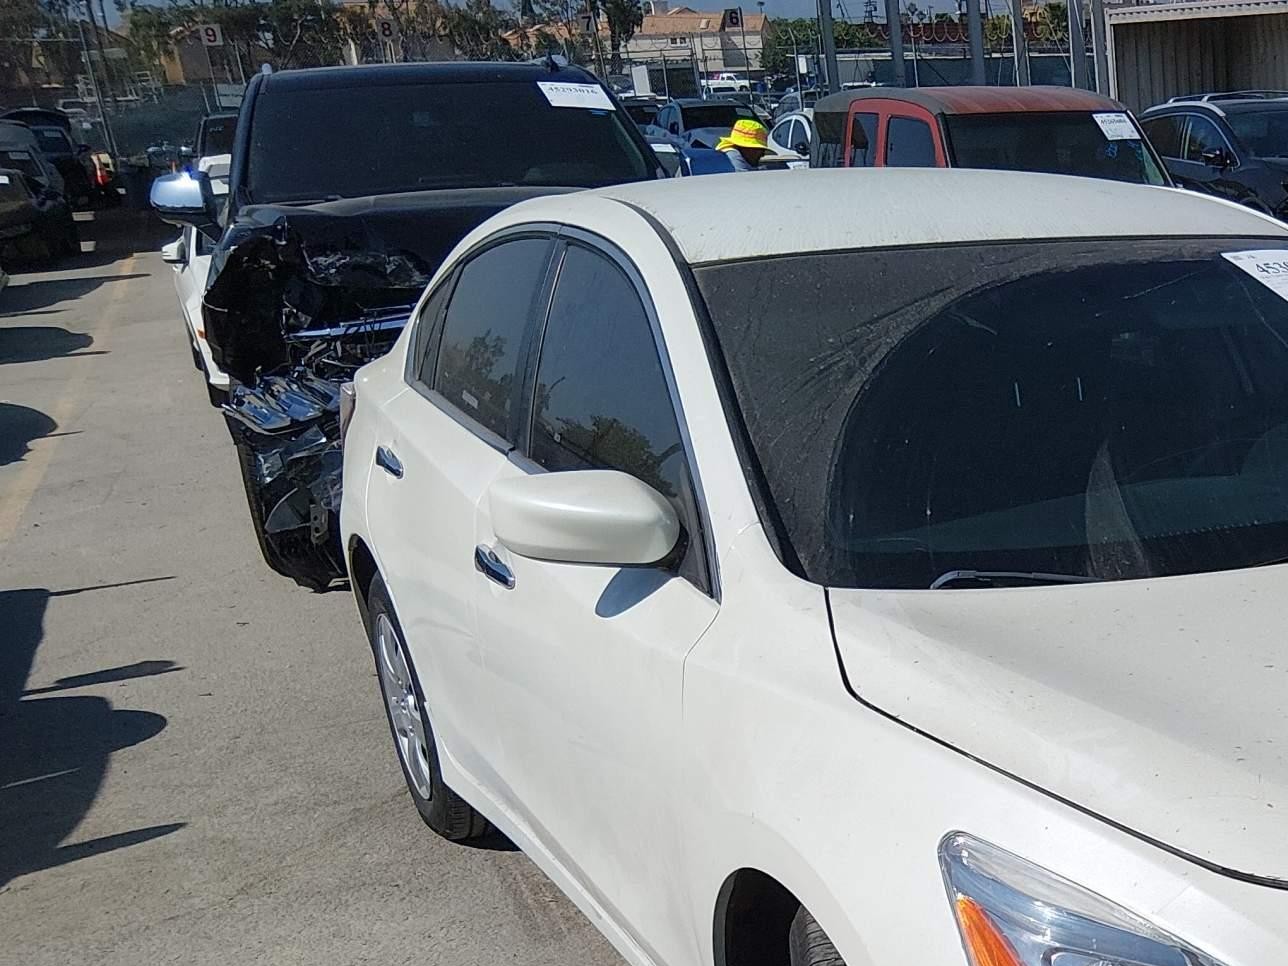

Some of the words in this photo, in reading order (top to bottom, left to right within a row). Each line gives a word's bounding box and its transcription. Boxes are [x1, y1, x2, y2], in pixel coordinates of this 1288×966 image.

[581, 16, 592, 31] 7
[730, 11, 739, 25] 6
[205, 27, 216, 43] 9
[382, 22, 392, 37] 8
